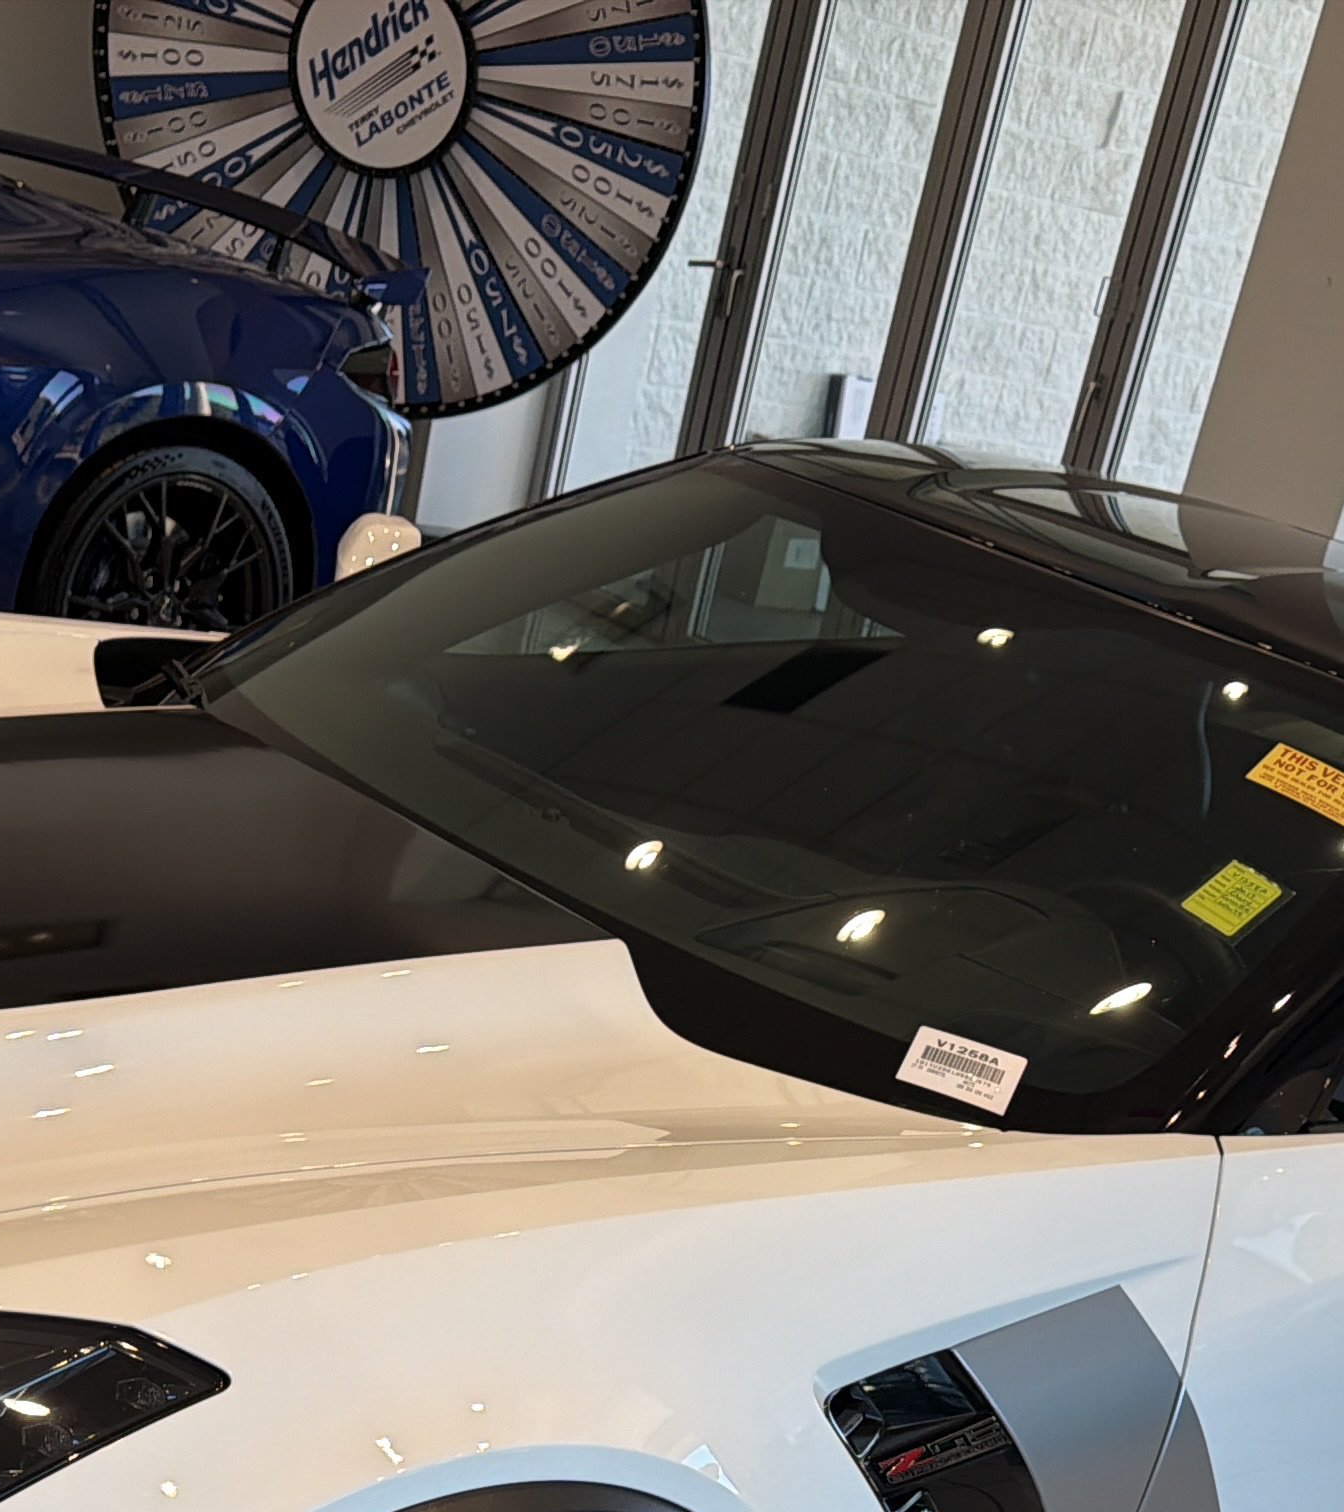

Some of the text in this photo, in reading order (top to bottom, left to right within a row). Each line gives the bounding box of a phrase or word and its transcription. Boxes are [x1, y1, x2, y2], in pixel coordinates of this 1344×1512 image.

[118, 48, 204, 66] $100
[309, 0, 429, 101] Hendrick
[590, 71, 685, 89] $175
[125, 111, 208, 143] $100
[355, 70, 450, 147] LABONTE
[395, 90, 454, 135] CHEVROLET
[589, 103, 683, 134] $100
[559, 126, 669, 178] $250
[571, 164, 654, 217] $100
[560, 191, 637, 257] $125
[506, 255, 560, 345] $125
[524, 237, 588, 318] $100
[457, 283, 495, 381] $150
[470, 248, 528, 367] $750
[432, 292, 460, 393] $100
[1273, 758, 1305, 777] NOT
[1307, 773, 1338, 795] FOR
[1279, 748, 1318, 771] THIS
